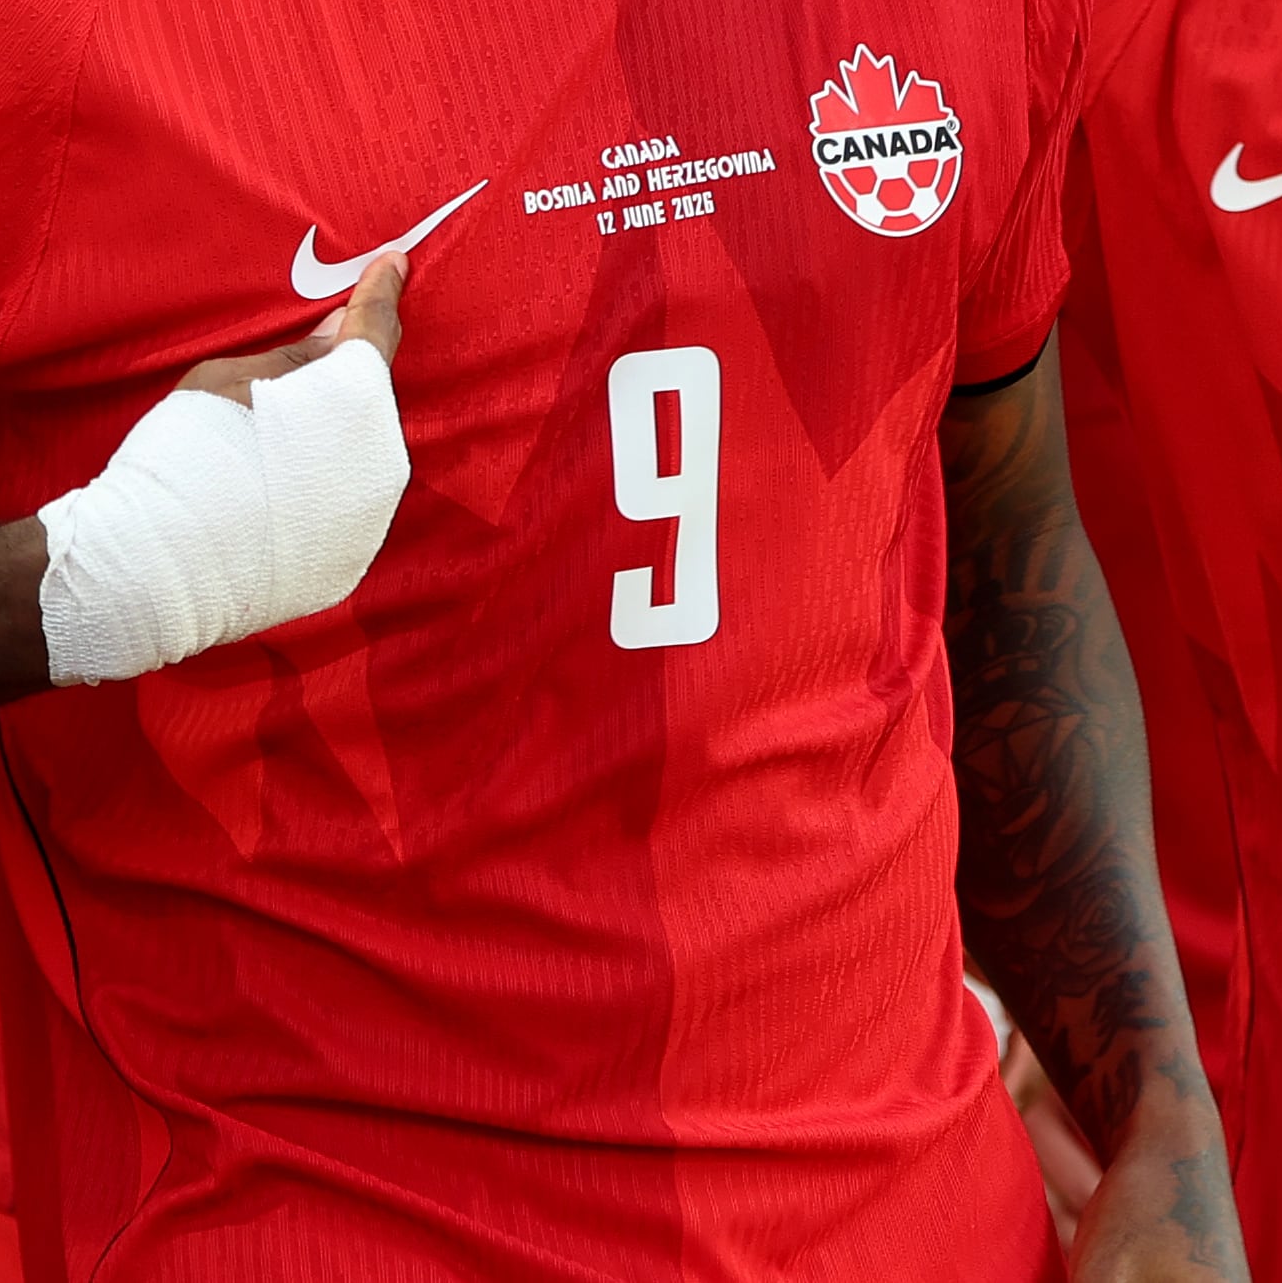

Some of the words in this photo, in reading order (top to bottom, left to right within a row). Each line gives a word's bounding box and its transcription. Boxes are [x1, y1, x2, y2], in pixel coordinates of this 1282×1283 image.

[601, 135, 680, 168] CANADA
[817, 126, 958, 165] CANADA
[524, 181, 596, 214] BOSNIA
[602, 173, 641, 200] AND
[647, 148, 776, 192] HERZEGOVINA
[597, 211, 616, 235] 12
[623, 201, 666, 230] JUNE
[671, 191, 715, 220] 2026
[608, 346, 720, 649] 9
